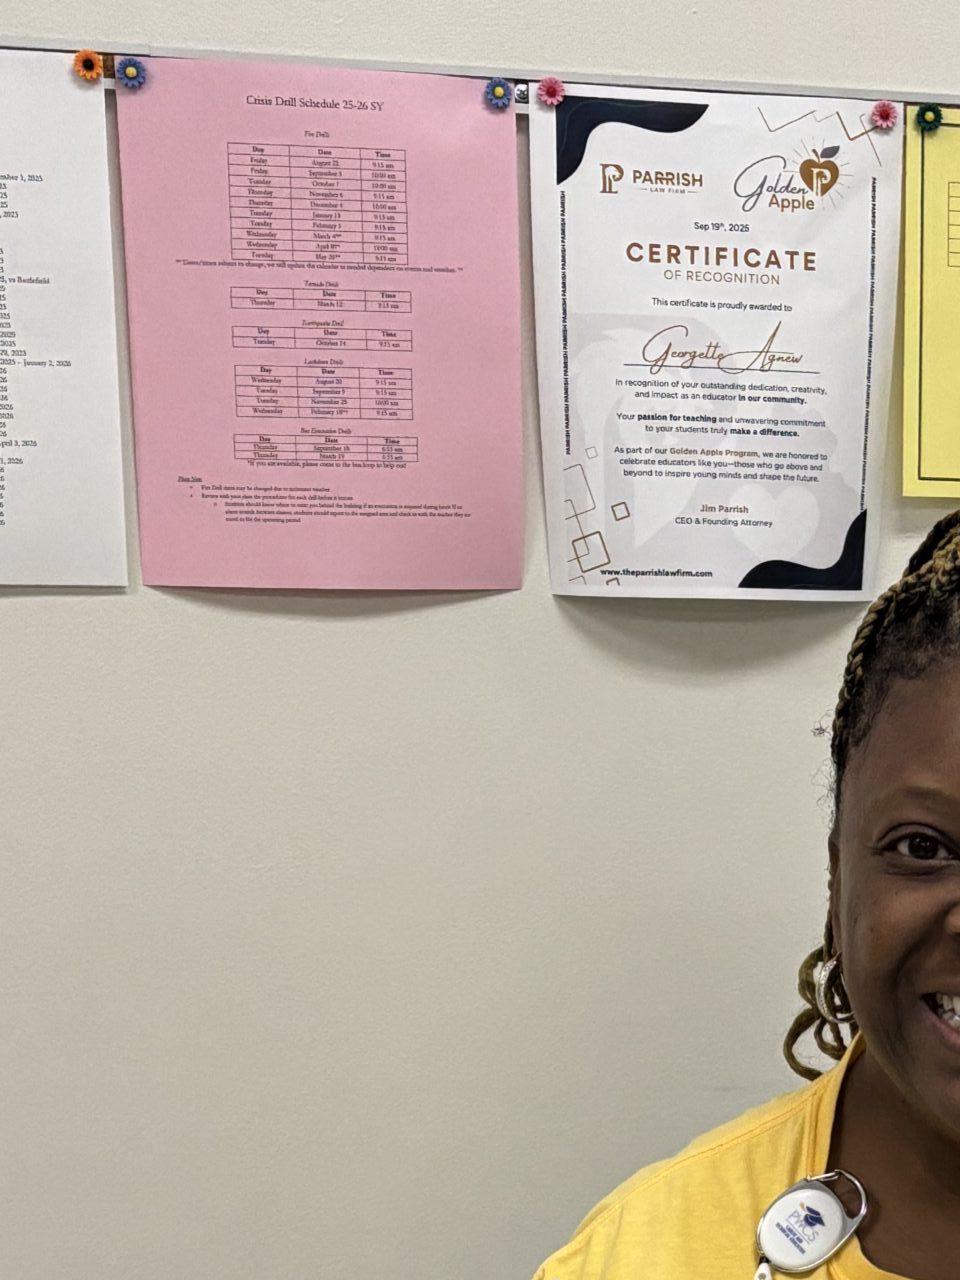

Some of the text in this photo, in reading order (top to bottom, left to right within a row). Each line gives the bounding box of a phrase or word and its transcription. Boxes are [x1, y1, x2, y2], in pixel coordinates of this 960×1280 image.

[247, 96, 384, 111] Crisis Drill Schedule 25-26 SY
[632, 169, 703, 187] PARRISH
[734, 155, 809, 212] Golden
[769, 193, 814, 212] Apple
[694, 222, 709, 231] Sep
[729, 224, 749, 232] 2025
[626, 242, 816, 271] CERTIFICATE
[664, 270, 779, 285] OF RECOGNITION
[652, 298, 668, 306] This
[670, 299, 708, 307] certificate
[718, 302, 747, 311] proudly
[642, 321, 803, 374] Georgette Agnew
[683, 415, 717, 423] teaching
[735, 418, 778, 426] unwavering
[700, 504, 748, 513] Jim Parrish
[702, 518, 738, 527] Founding
[741, 519, 772, 528] Attorney
[600, 568, 713, 578] www.theparrishlawfirm.com
